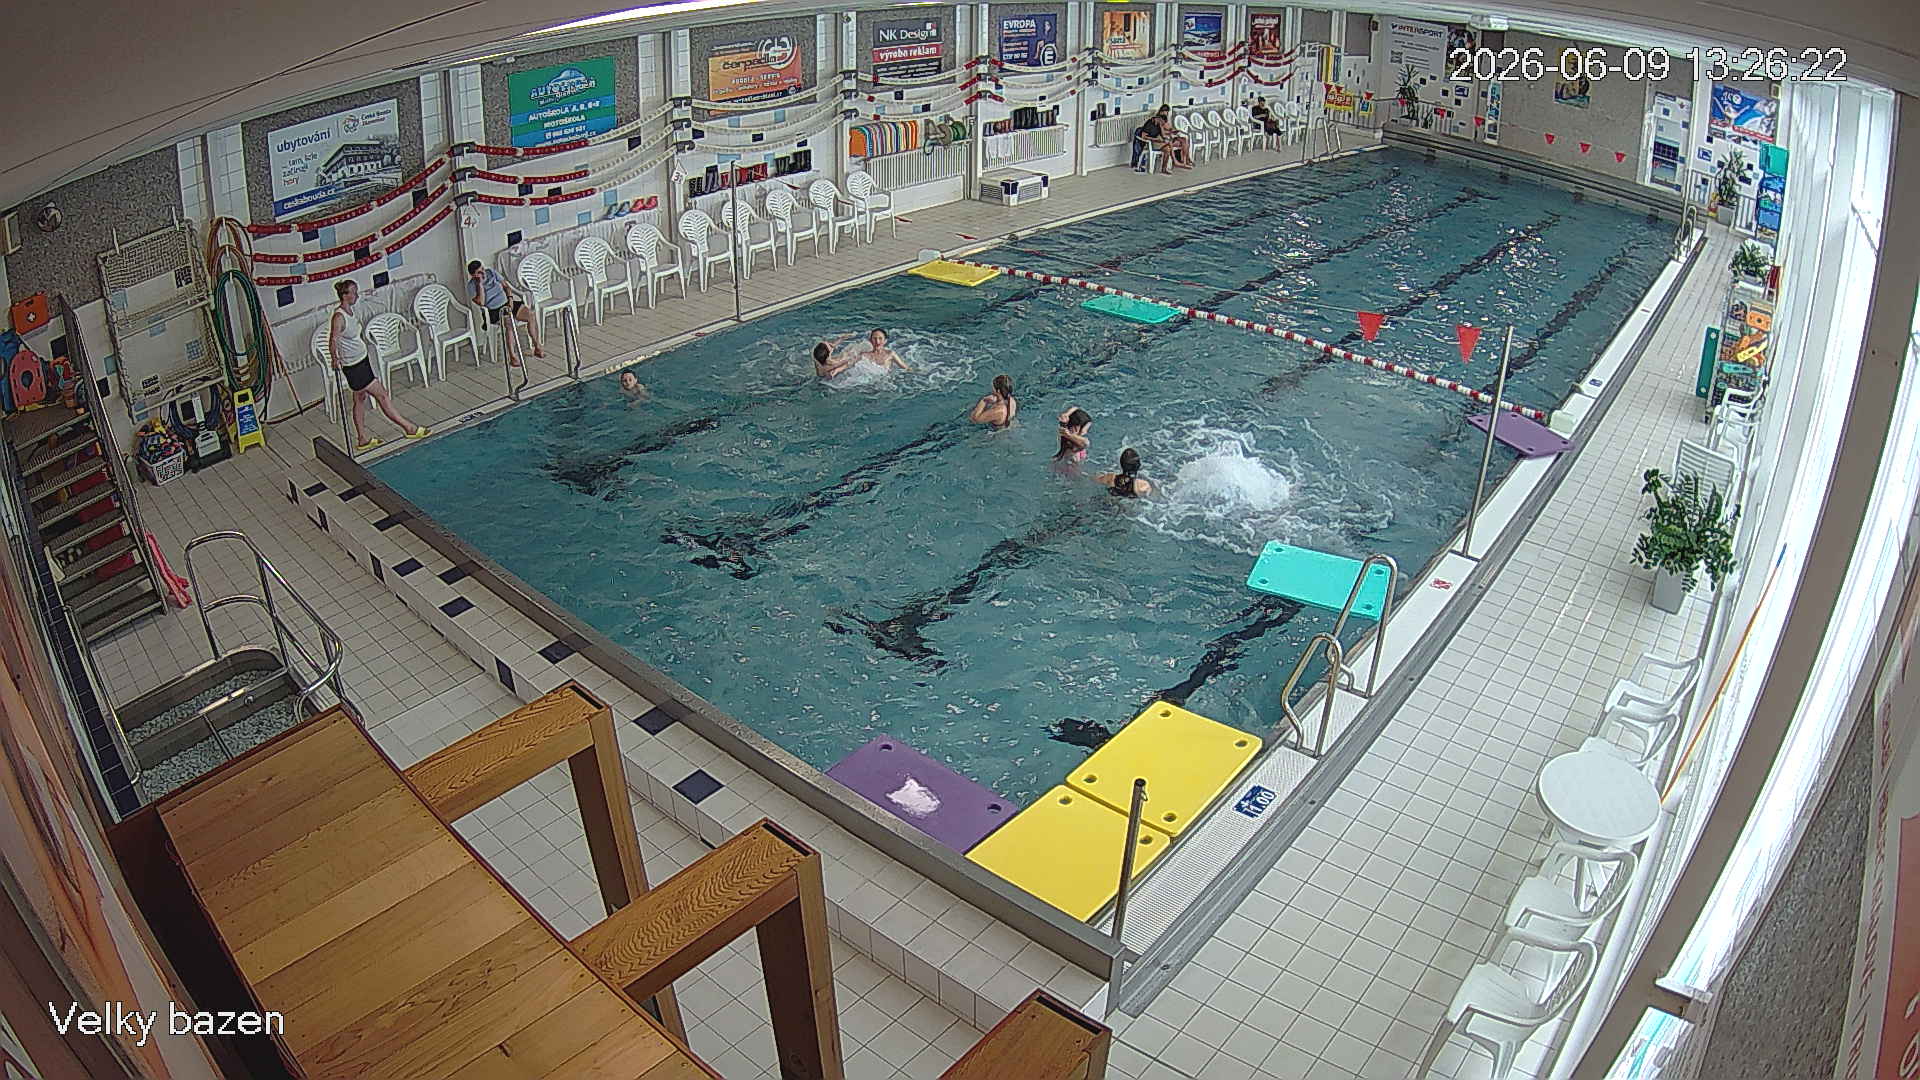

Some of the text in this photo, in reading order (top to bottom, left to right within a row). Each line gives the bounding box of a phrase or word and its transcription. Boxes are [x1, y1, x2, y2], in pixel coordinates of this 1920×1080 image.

[1003, 19, 1036, 30] EVROPA
[880, 28, 898, 42] NK
[880, 46, 937, 62] výroba reklam
[276, 127, 331, 153] ubytování
